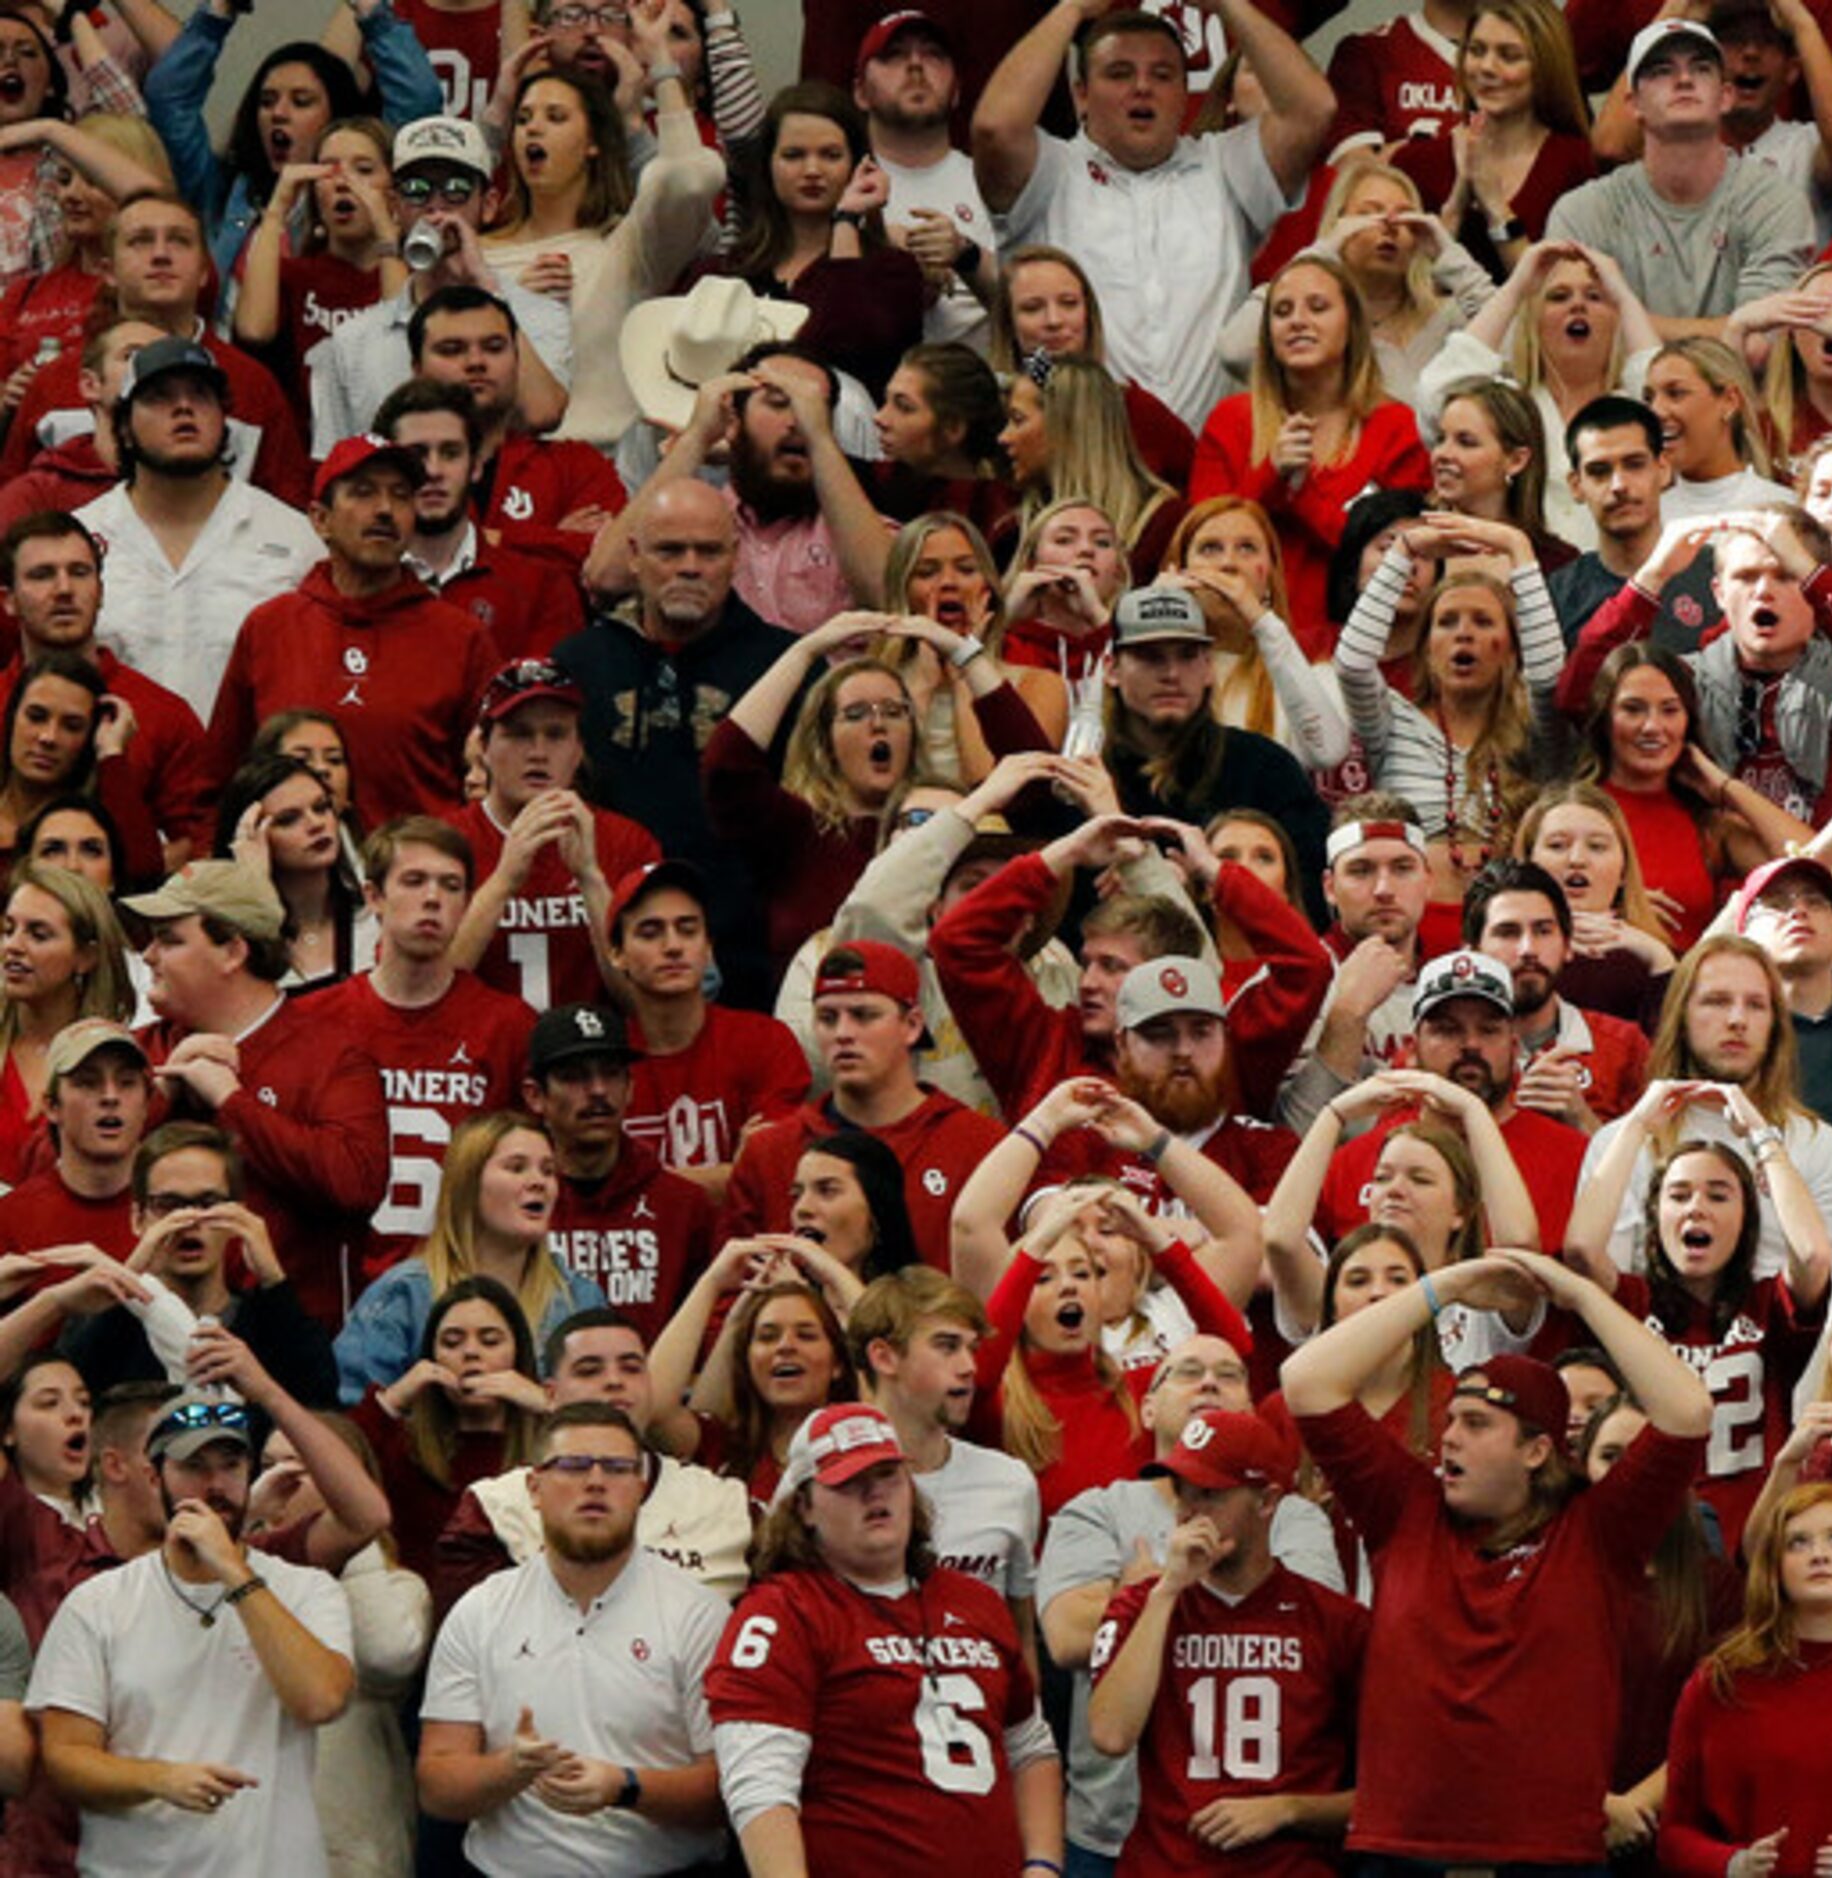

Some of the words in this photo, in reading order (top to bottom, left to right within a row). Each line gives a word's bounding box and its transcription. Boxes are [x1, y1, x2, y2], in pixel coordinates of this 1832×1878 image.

[607, 1271, 656, 1304] ONE
[1707, 1350, 1763, 1476] 2
[732, 1614, 778, 1669] 6
[866, 1635, 999, 1669] SOONERS
[1173, 1634, 1302, 1672] SOONERS
[913, 1672, 995, 1796] 6
[1186, 1674, 1281, 1780] 18
